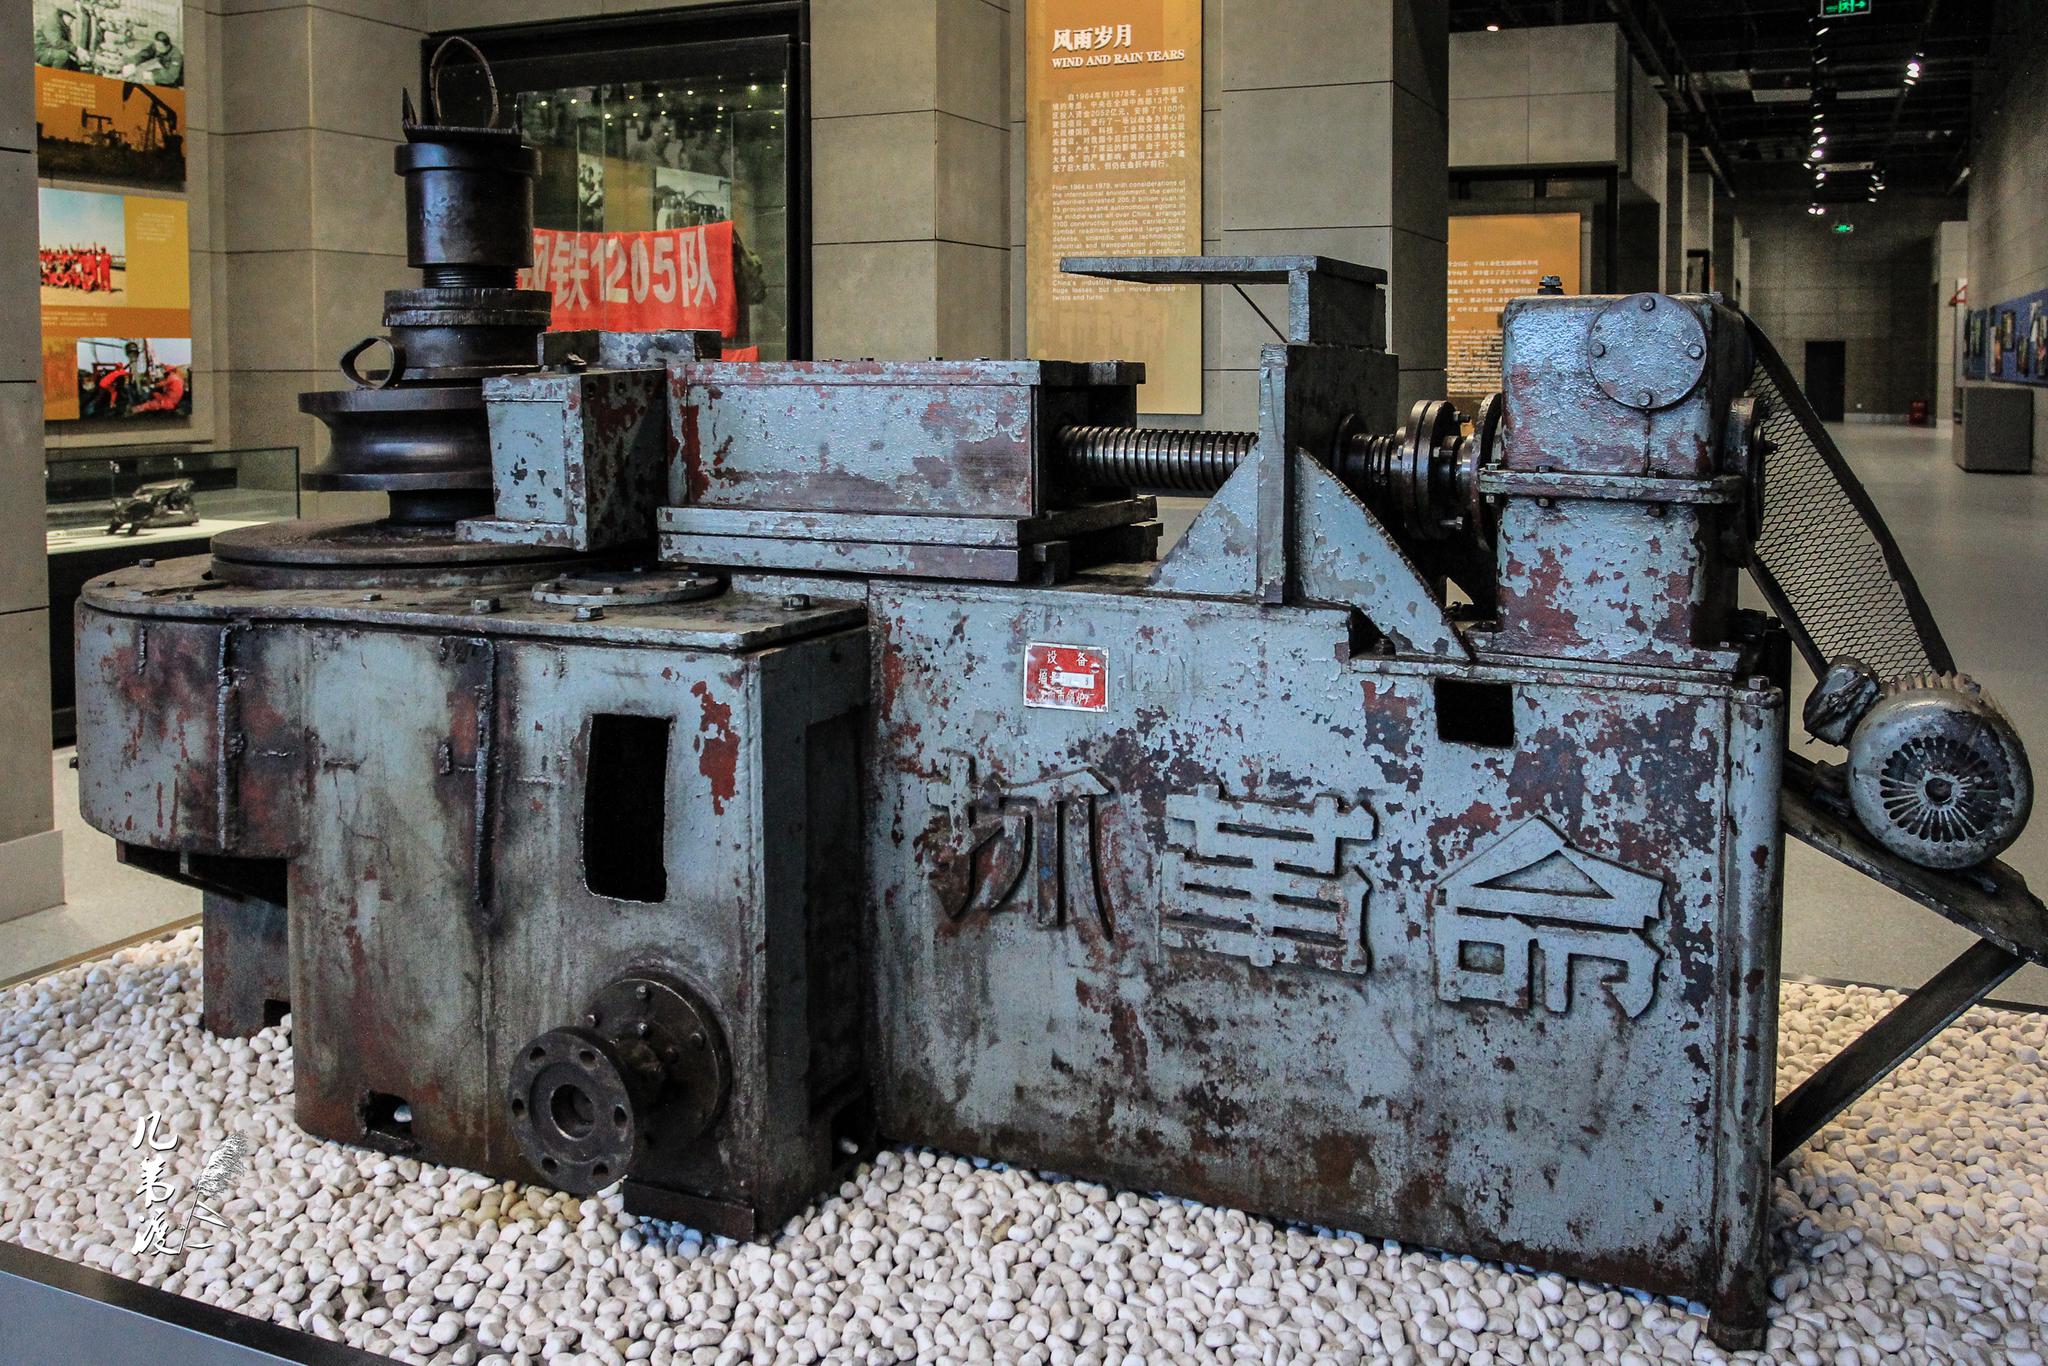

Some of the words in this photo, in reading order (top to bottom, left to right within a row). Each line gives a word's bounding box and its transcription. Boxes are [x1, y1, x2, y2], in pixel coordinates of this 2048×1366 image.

[1052, 23, 1132, 52] 风雨岁月
[1052, 57, 1084, 69] WIND
[1086, 55, 1112, 67] AND
[1114, 52, 1143, 65] RAIN
[1146, 49, 1185, 62] YEARS
[1128, 179, 1177, 187] considerations
[1047, 650, 1088, 667] 设备
